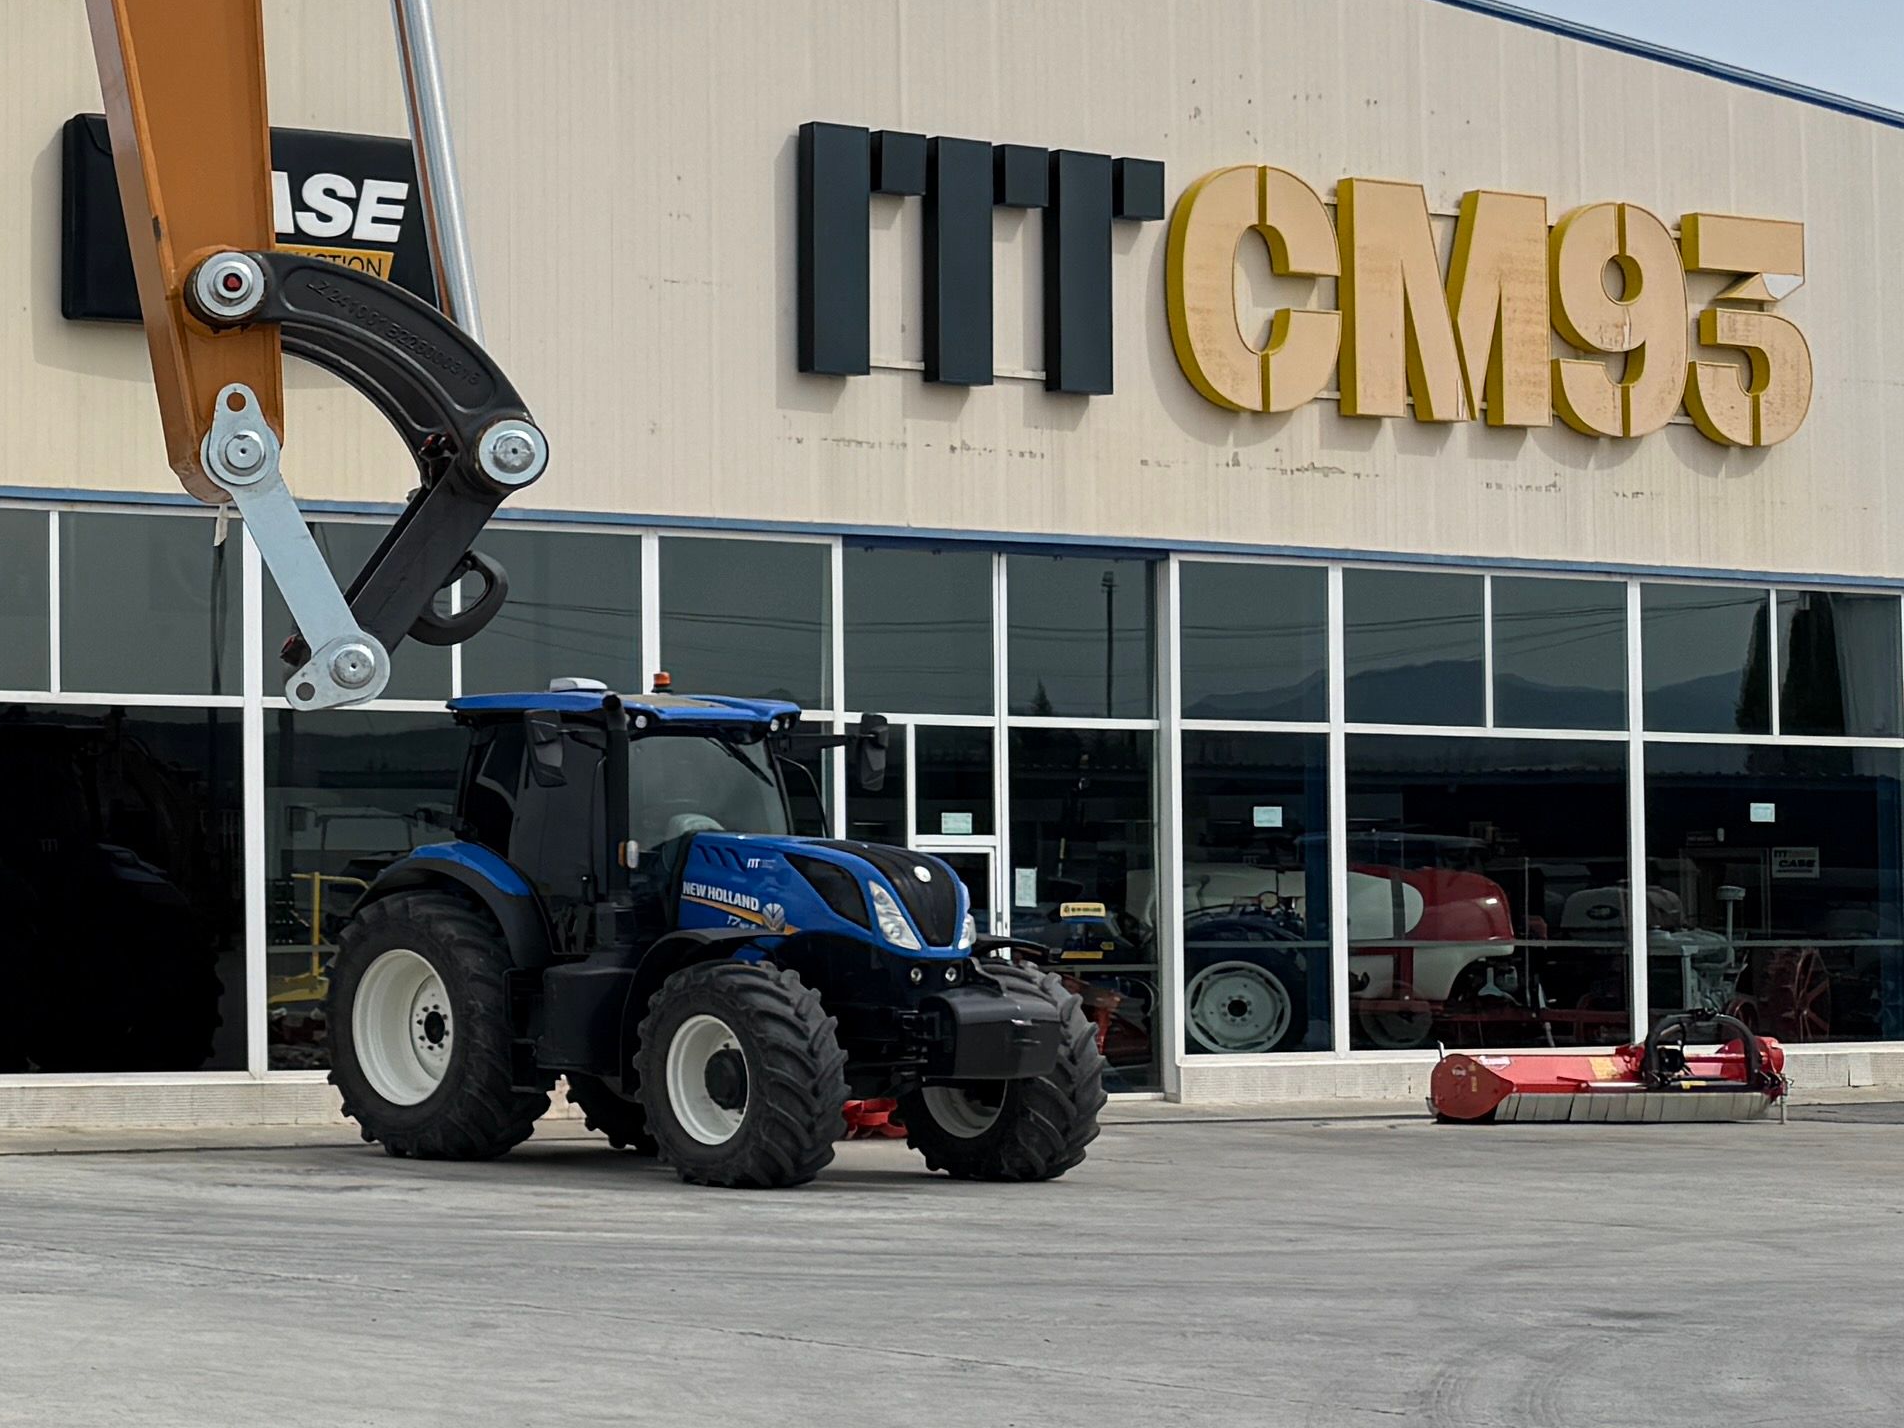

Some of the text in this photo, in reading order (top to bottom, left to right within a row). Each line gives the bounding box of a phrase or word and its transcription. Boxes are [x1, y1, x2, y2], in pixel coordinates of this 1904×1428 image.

[1165, 164, 1814, 447] CM93
[683, 881, 760, 911] NEW HOLLAND
